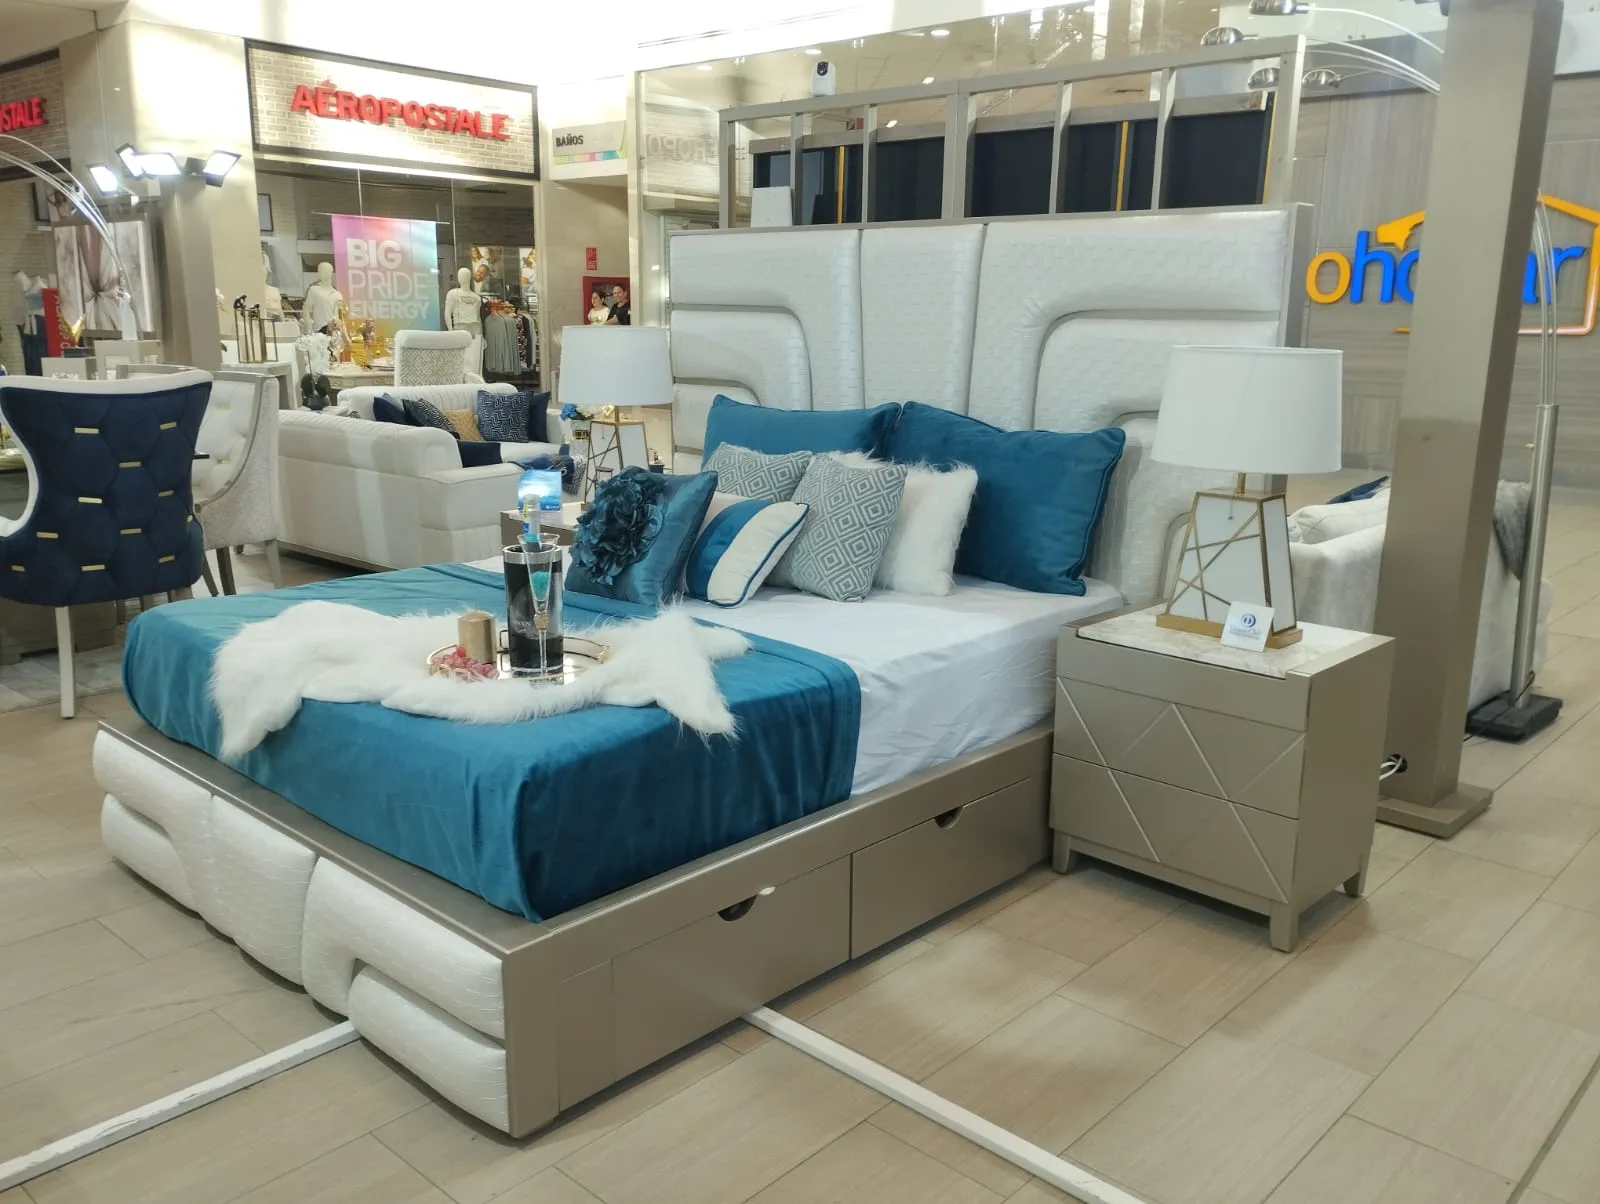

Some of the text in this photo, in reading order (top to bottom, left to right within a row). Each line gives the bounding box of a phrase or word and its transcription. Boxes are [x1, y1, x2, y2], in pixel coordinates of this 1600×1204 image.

[0, 96, 46, 132] STALE
[290, 80, 510, 141] AÉROPOSTALE
[556, 134, 584, 147] BAÑOS
[346, 238, 402, 269] BIG
[348, 269, 430, 300] PRIDE
[349, 300, 430, 319] ENERGY
